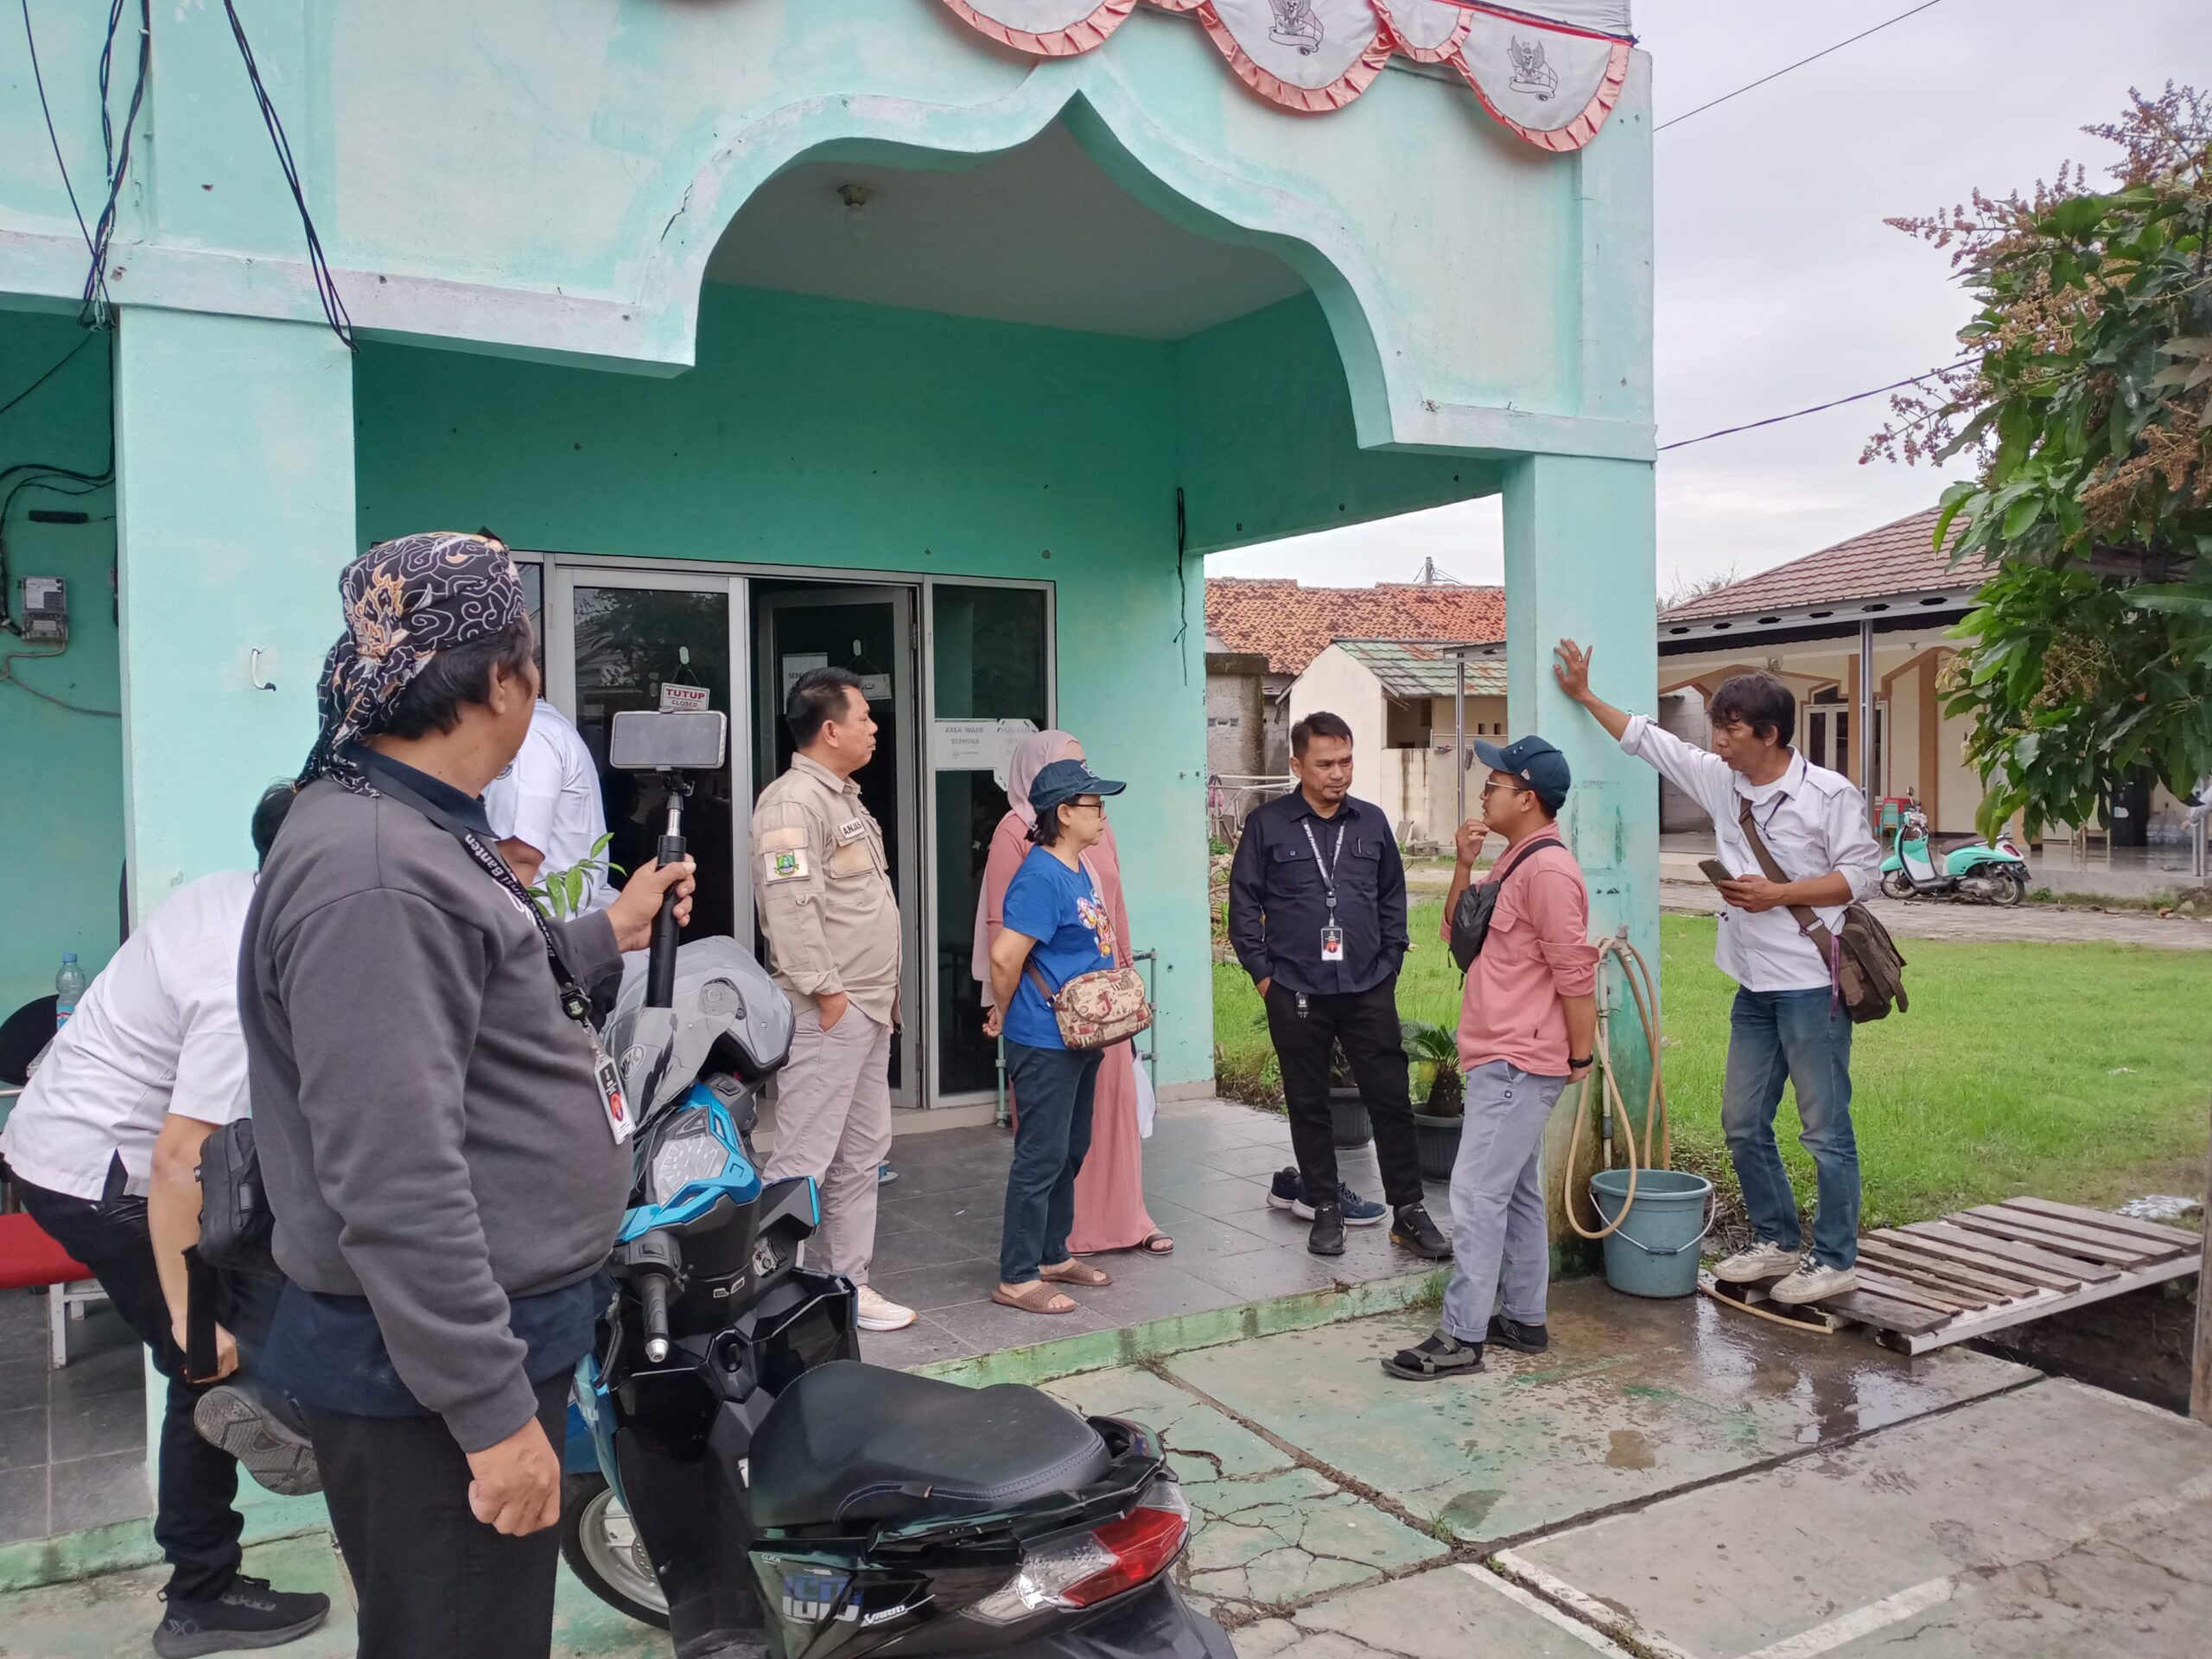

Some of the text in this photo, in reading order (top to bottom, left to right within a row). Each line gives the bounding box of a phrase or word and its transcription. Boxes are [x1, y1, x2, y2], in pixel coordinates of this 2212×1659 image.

[666, 689, 705, 699] TUTUP
[465, 834, 504, 877] Banten
[864, 1605, 906, 1624] VARIO
